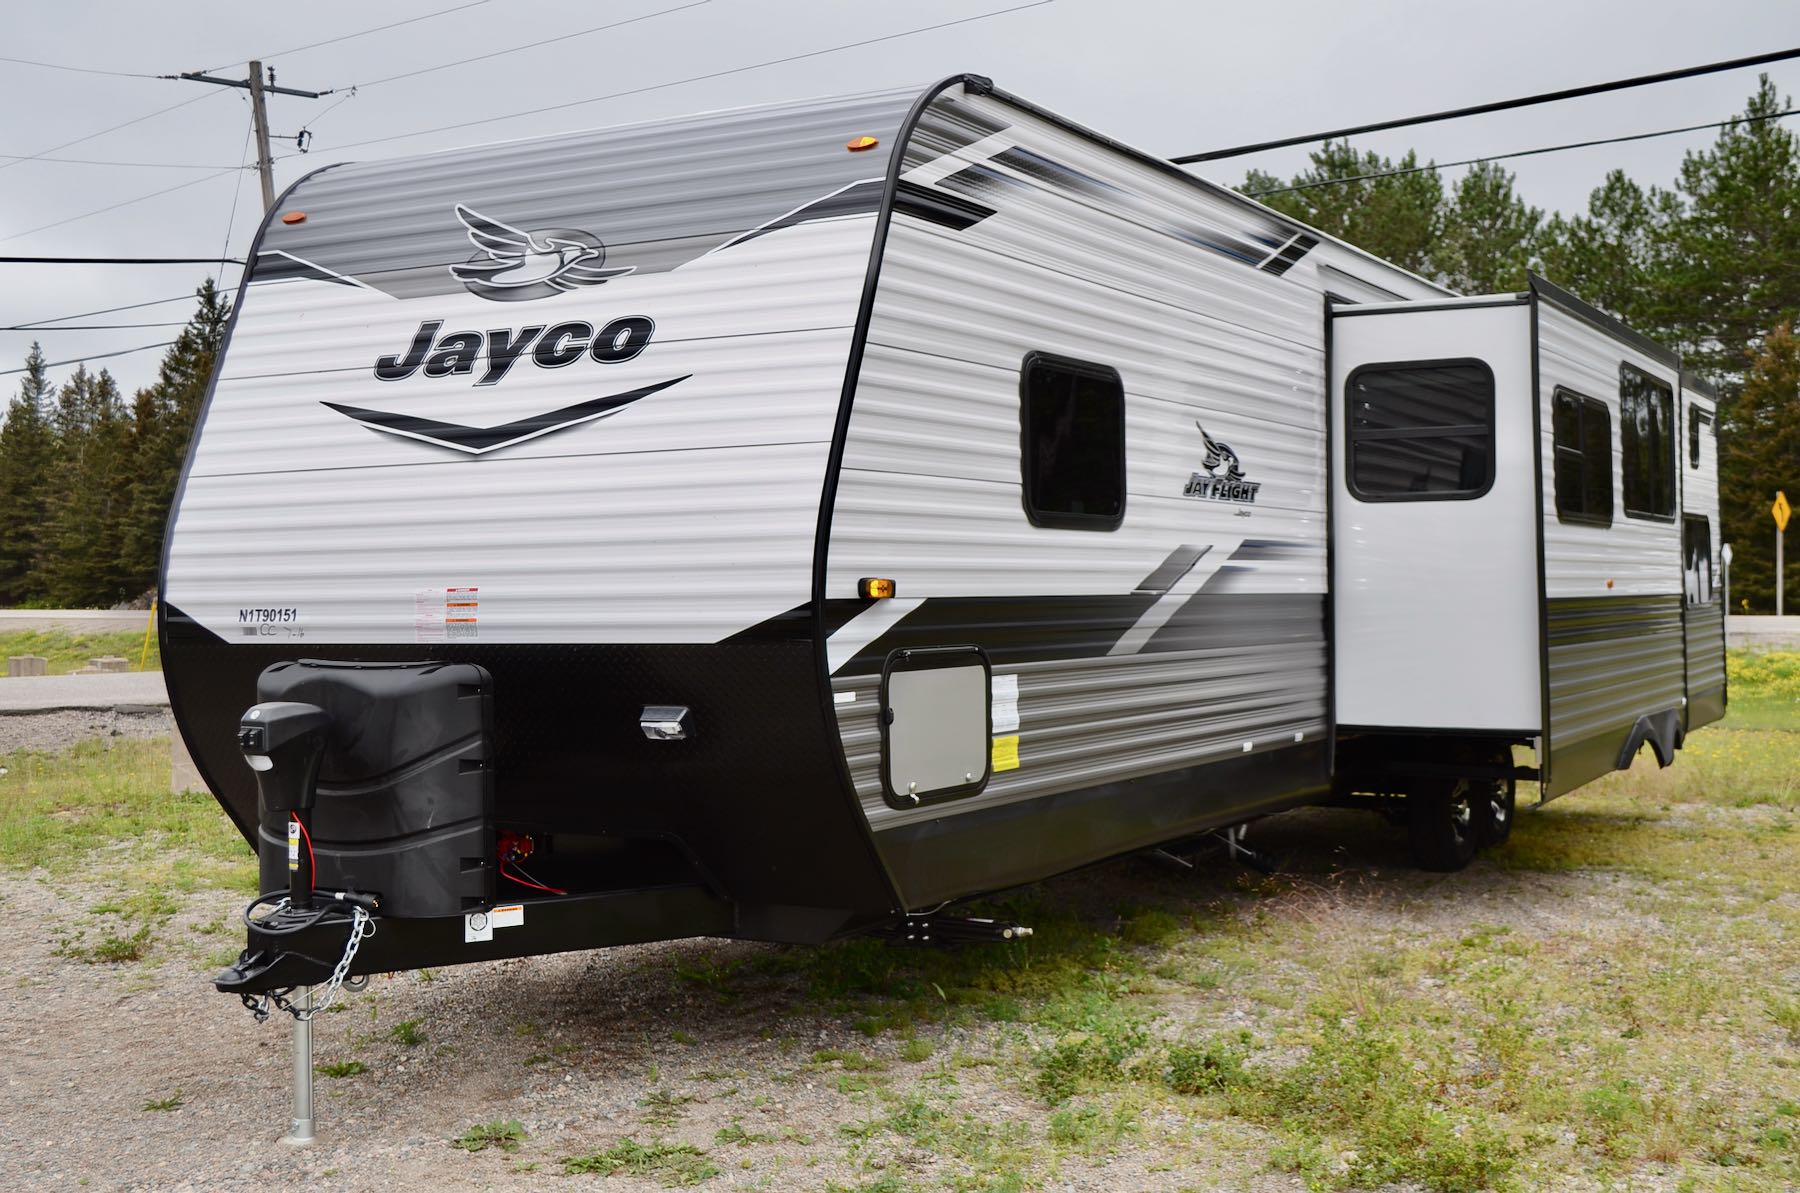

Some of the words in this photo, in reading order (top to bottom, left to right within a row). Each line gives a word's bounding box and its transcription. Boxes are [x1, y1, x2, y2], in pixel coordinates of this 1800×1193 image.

[374, 315, 656, 387] Jayco
[1184, 479, 1209, 498] JAY
[1210, 481, 1260, 503] FLIGHT
[239, 608, 297, 622] N1T90151
